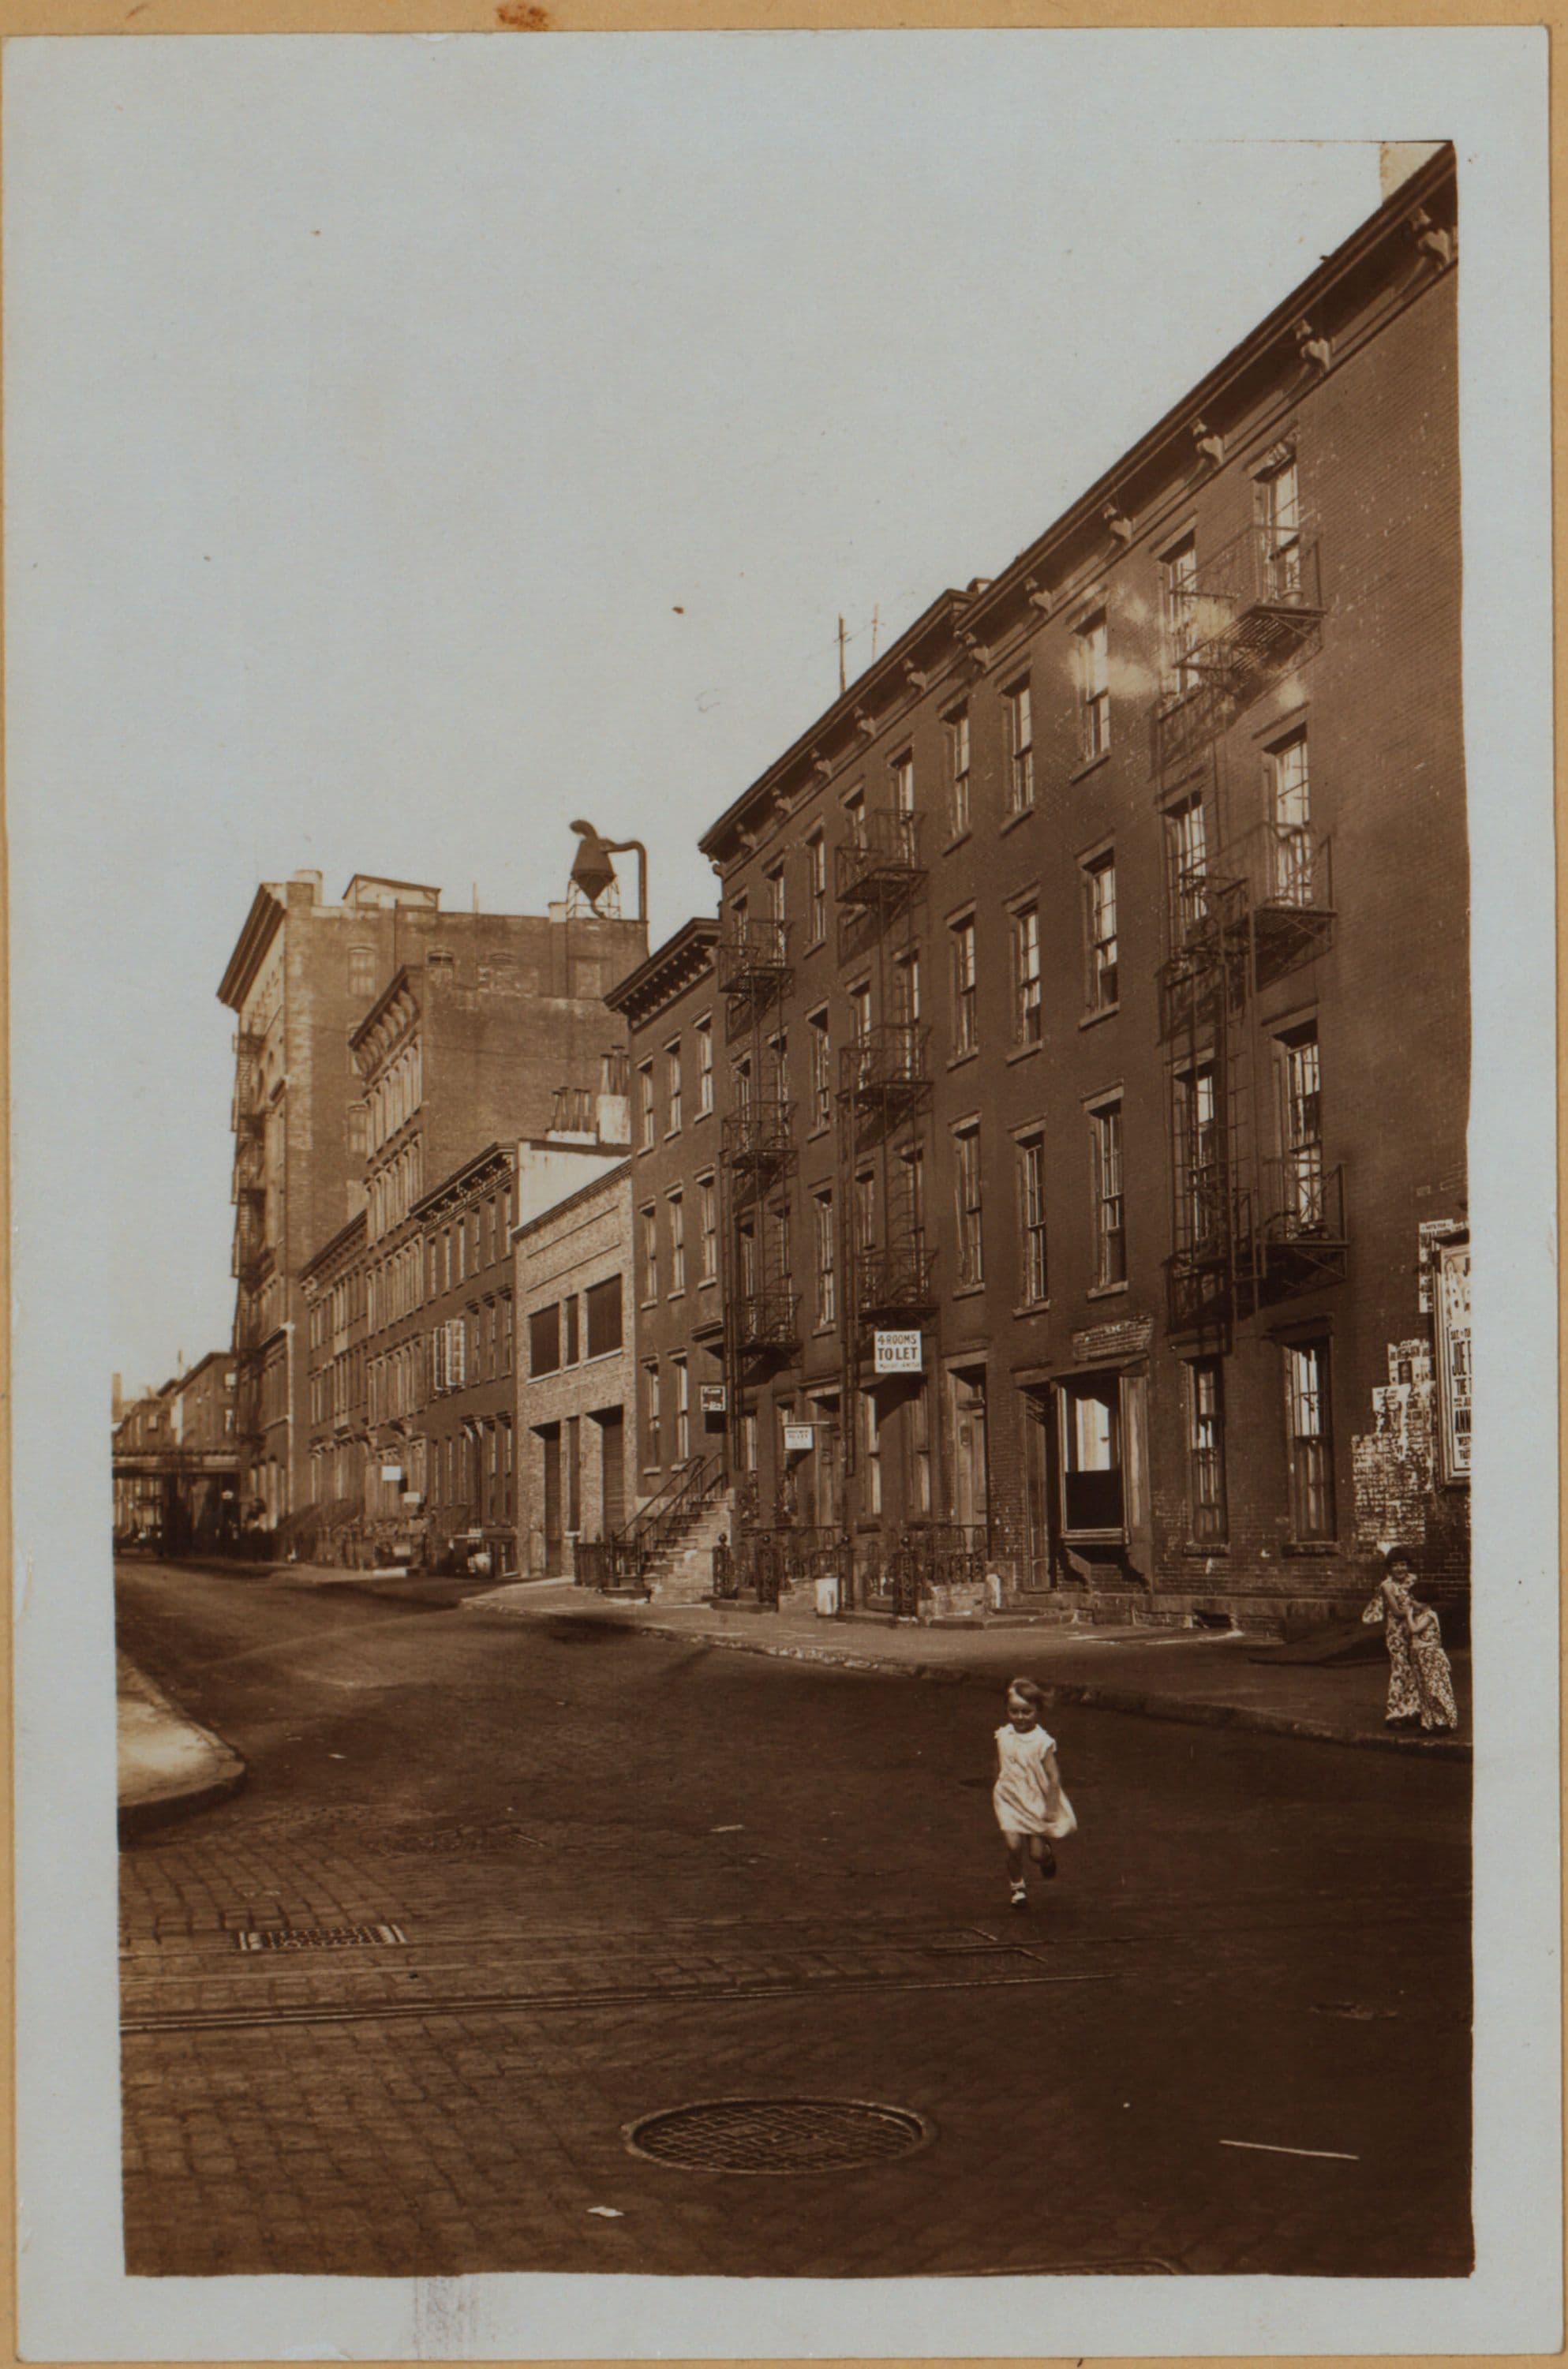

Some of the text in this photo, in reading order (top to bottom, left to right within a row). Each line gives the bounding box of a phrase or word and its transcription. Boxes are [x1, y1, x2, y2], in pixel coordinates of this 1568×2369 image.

[885, 1334, 917, 1345] ROOMS
[878, 1346, 918, 1360] TO LET
